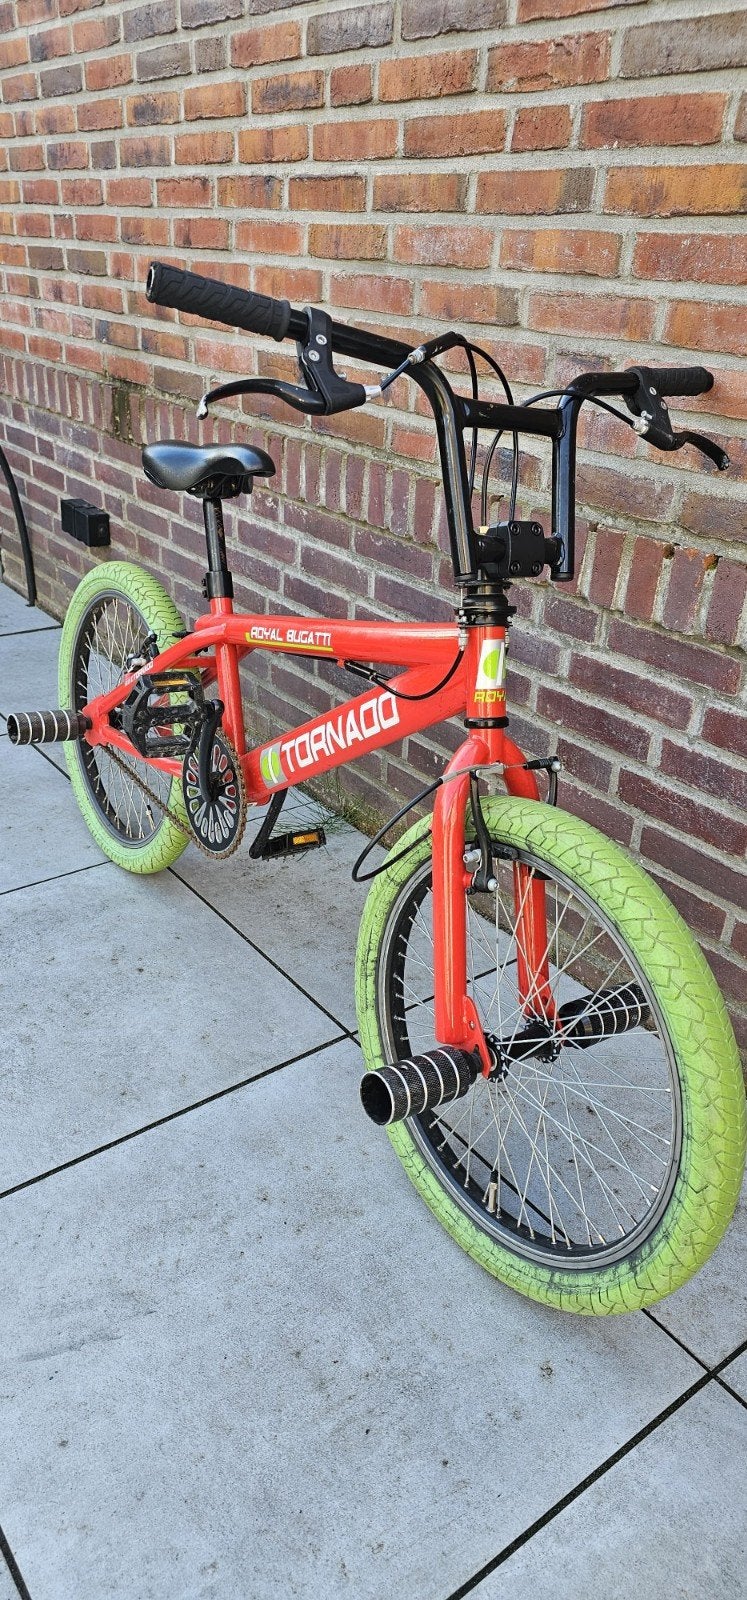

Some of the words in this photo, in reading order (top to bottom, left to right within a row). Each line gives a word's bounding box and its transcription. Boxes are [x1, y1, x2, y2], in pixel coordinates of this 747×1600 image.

[250, 626, 283, 642] ROYAL
[286, 629, 331, 646] BUGATTI
[473, 690, 506, 703] ROY
[281, 690, 400, 772] TORNADO
